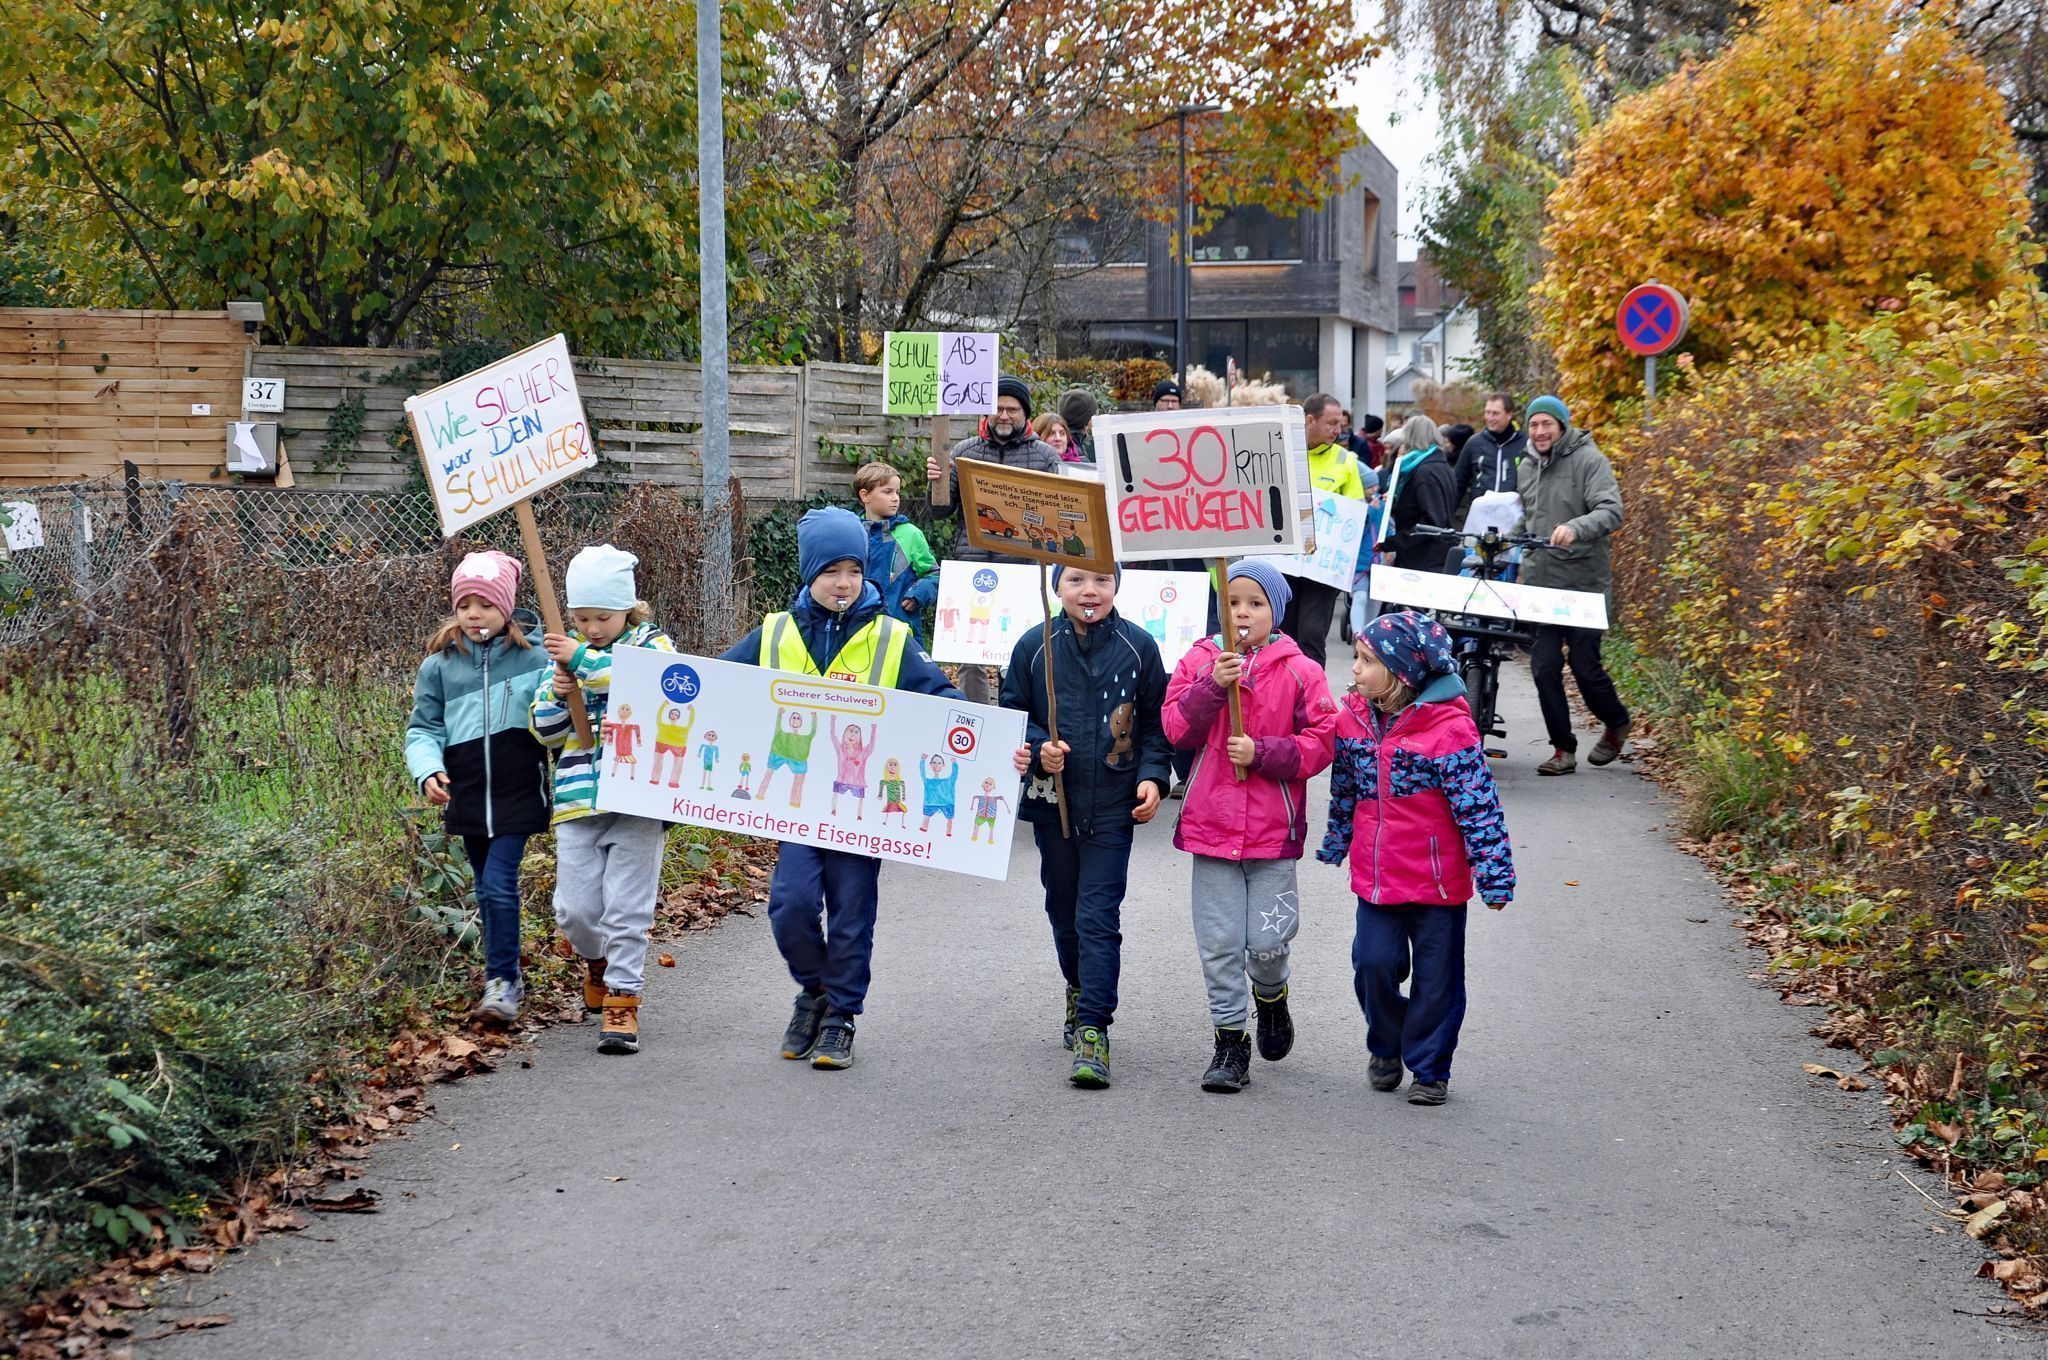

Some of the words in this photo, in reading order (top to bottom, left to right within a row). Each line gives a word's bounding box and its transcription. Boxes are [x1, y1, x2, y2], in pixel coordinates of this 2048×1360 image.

[889, 340, 938, 368] SCHUL-
[945, 335, 988, 365] AB-
[923, 370, 951, 383] statt
[250, 381, 278, 400] 37
[424, 400, 477, 449] Wie
[475, 357, 569, 427] SICHER
[442, 448, 473, 475] war
[486, 408, 543, 457] DEIN
[1142, 425, 1227, 491] 30
[975, 478, 989, 487] Wir
[1019, 488, 1042, 497] sicher
[1060, 494, 1082, 504] leise,
[979, 487, 999, 496] rasen
[1008, 493, 1021, 501] der
[1022, 495, 1061, 508] Eisengasse
[1063, 502, 1074, 510] ist
[777, 687, 821, 700] Sicherer
[824, 692, 878, 707] Schulweg!
[956, 714, 976, 727] ZONE
[954, 734, 969, 747] 30
[672, 797, 810, 837] Kindersichere
[817, 823, 932, 859] Eisengasse!
